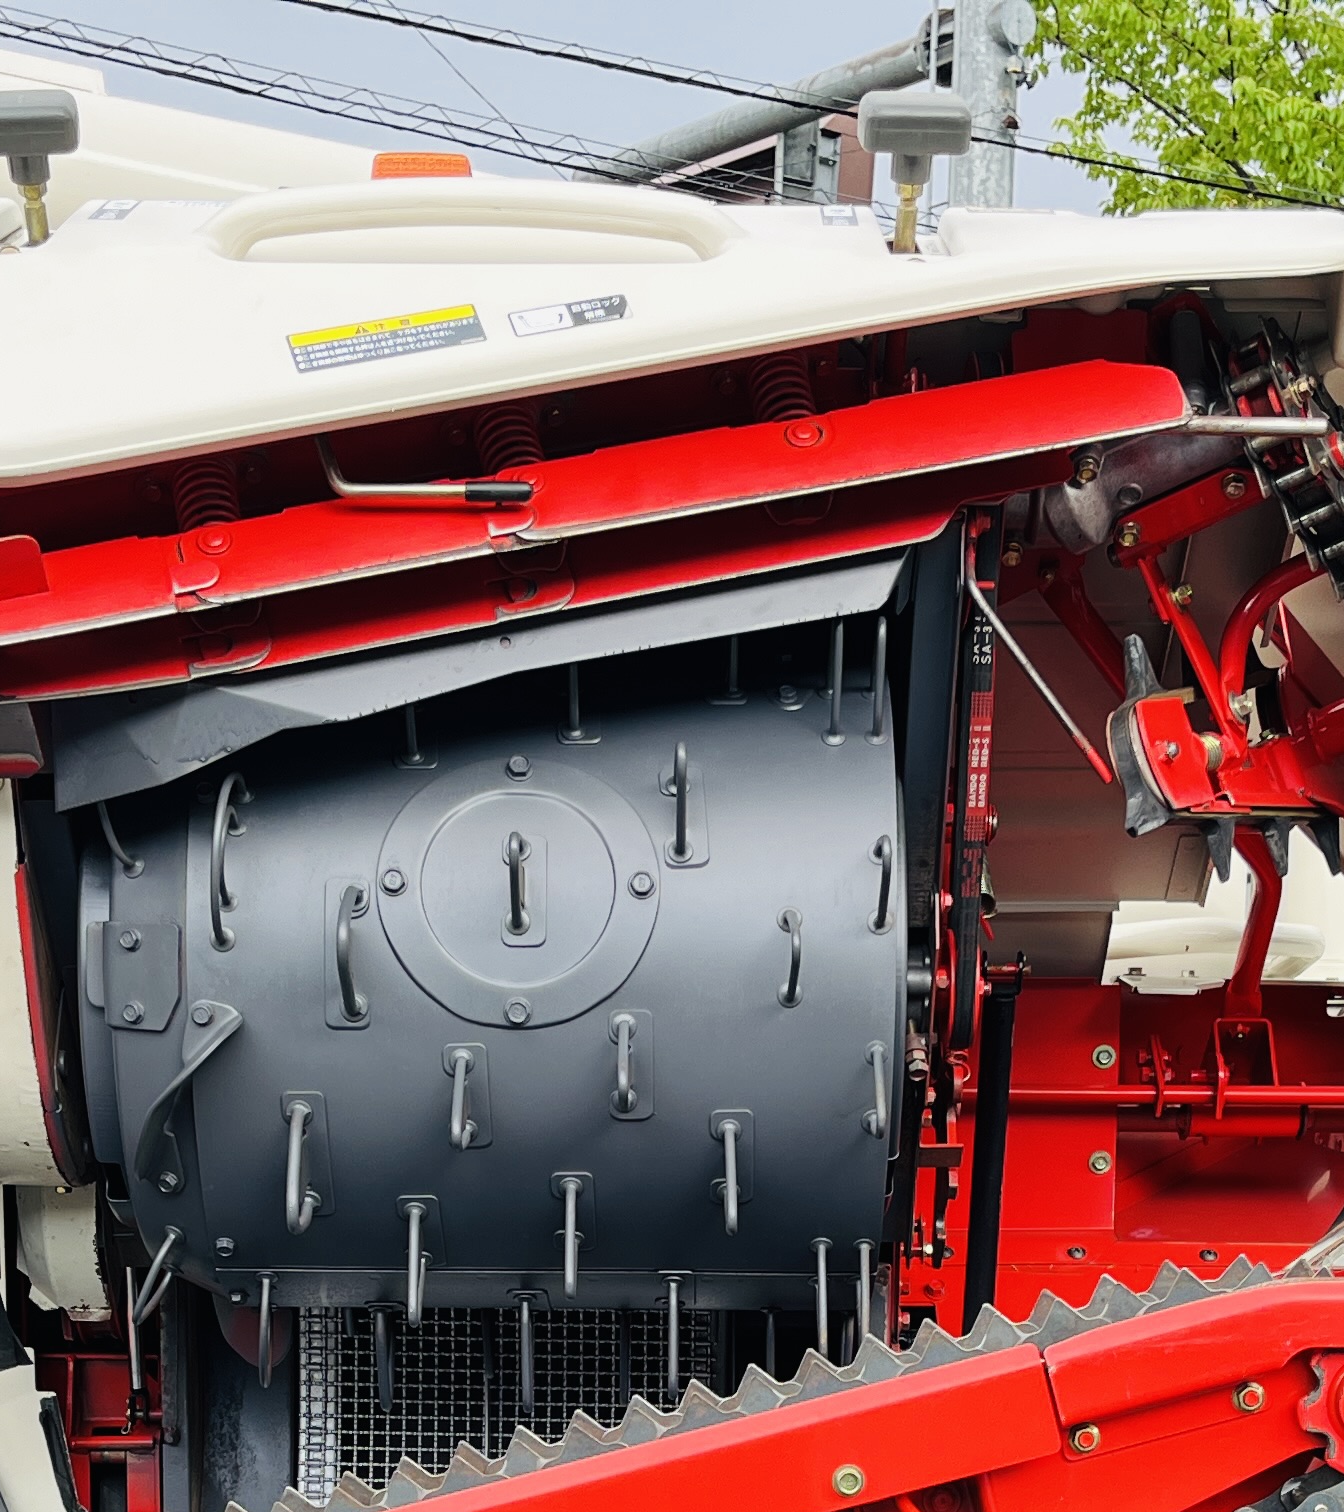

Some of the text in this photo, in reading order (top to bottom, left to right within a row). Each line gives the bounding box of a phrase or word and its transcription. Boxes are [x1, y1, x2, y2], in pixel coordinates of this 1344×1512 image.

[981, 617, 993, 665] SA-3
[980, 737, 990, 768] RED-S
[968, 774, 978, 808] BANDO
[978, 773, 987, 808] BANDO
